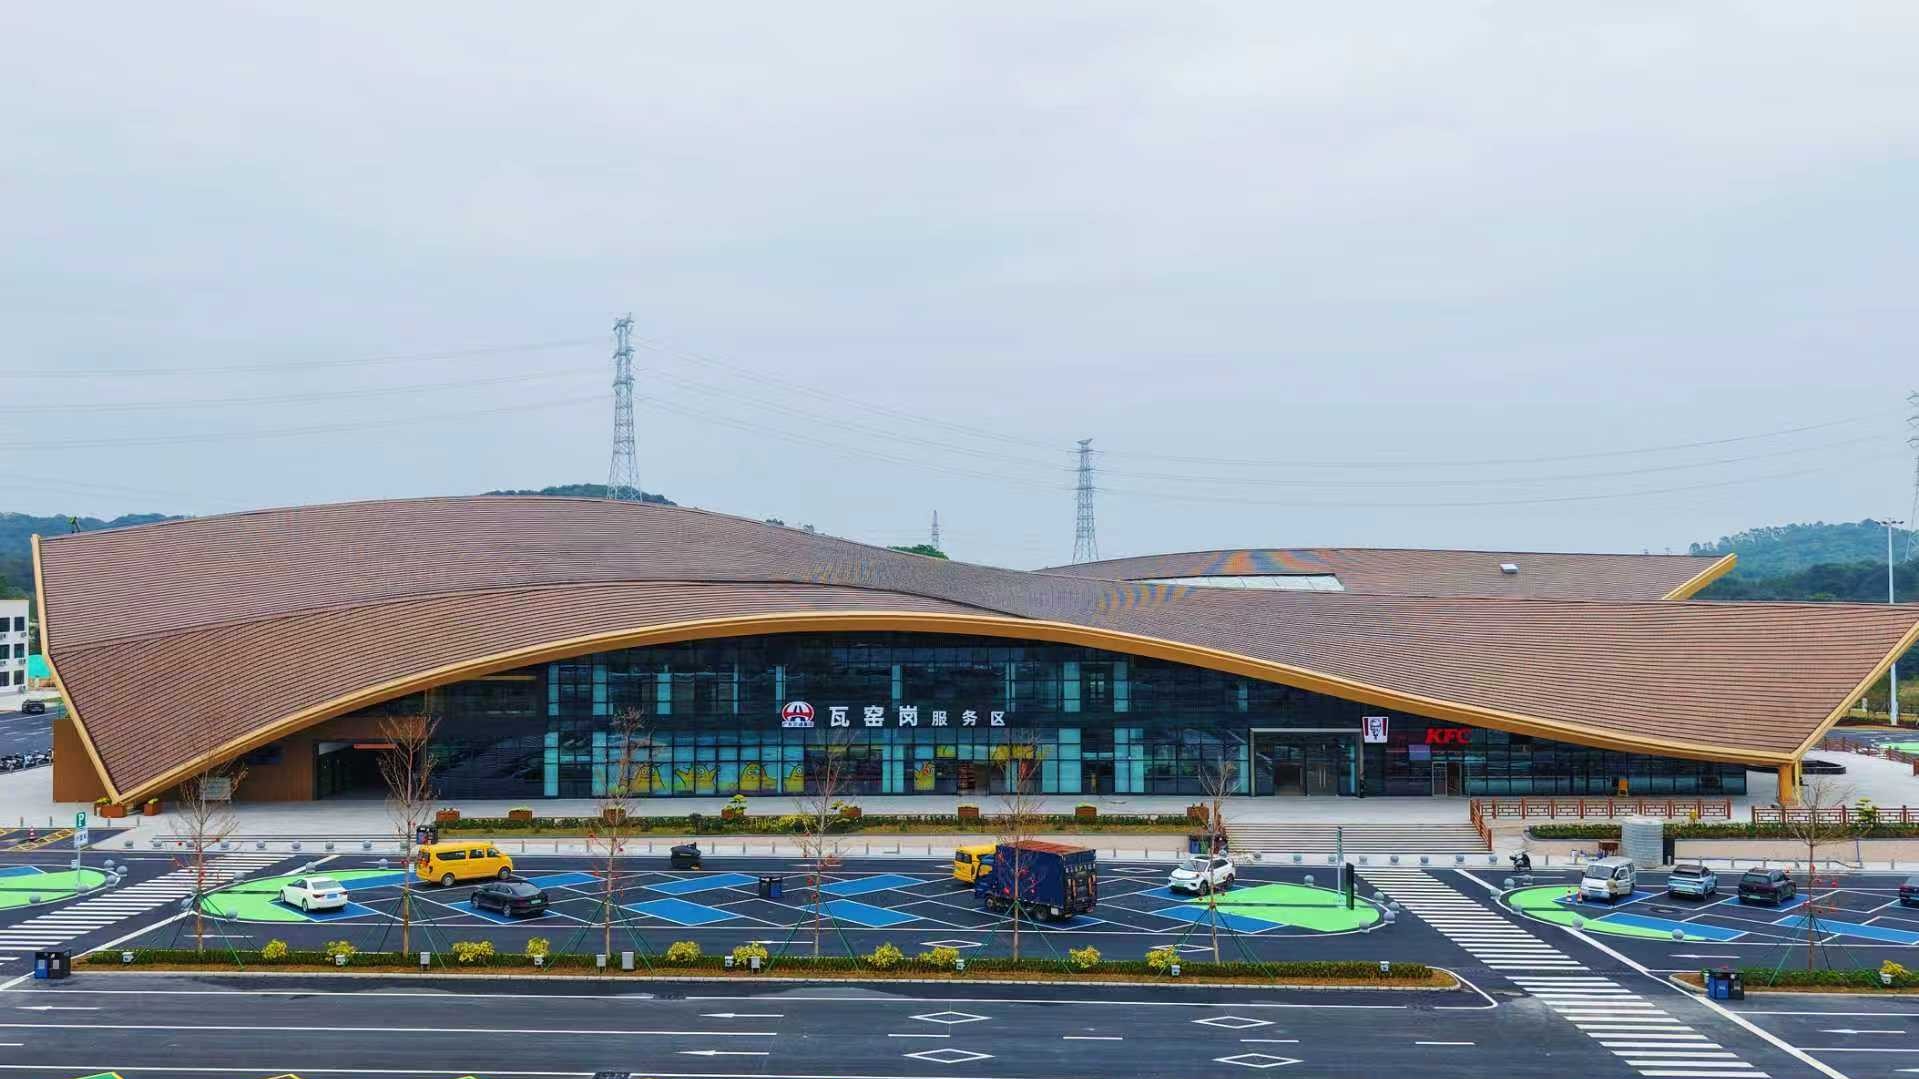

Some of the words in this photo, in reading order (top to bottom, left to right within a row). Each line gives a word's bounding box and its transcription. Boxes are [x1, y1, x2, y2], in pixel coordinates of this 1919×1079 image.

[829, 705, 1005, 727] 瓦窑岗服务区
[1425, 727, 1471, 745] KFC
